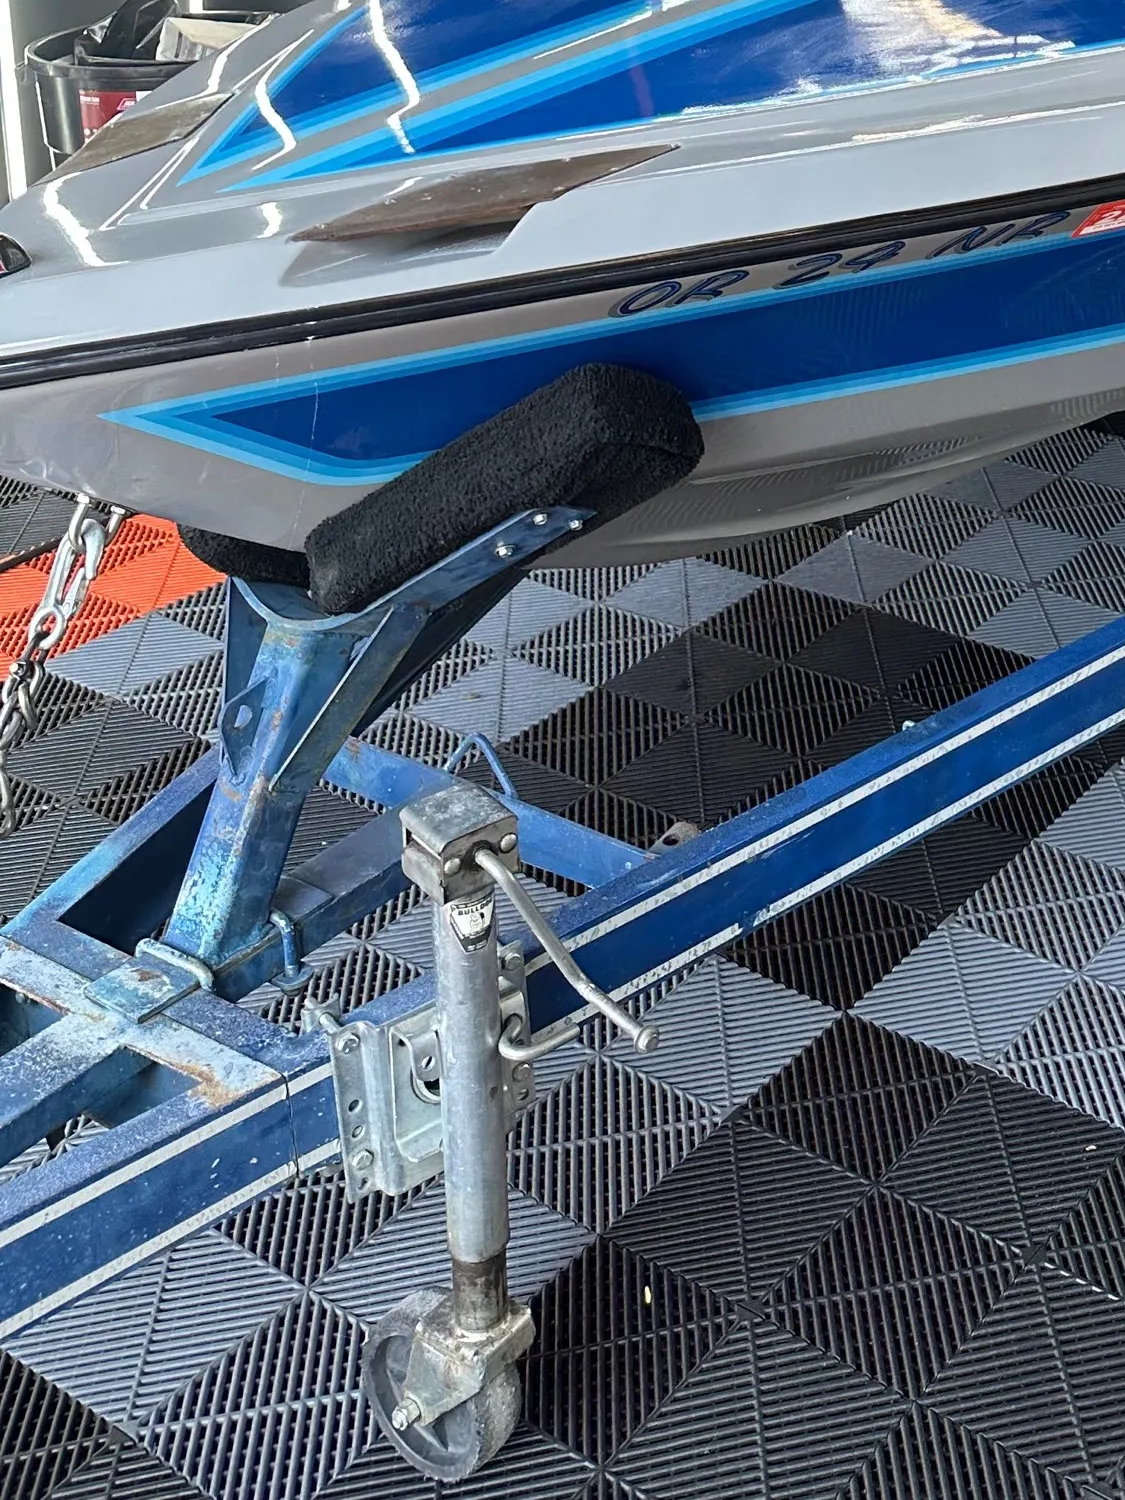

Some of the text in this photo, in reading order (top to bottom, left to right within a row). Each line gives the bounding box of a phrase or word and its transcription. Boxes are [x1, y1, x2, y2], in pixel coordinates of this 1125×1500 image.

[609, 210, 1072, 318] OR 24 NR
